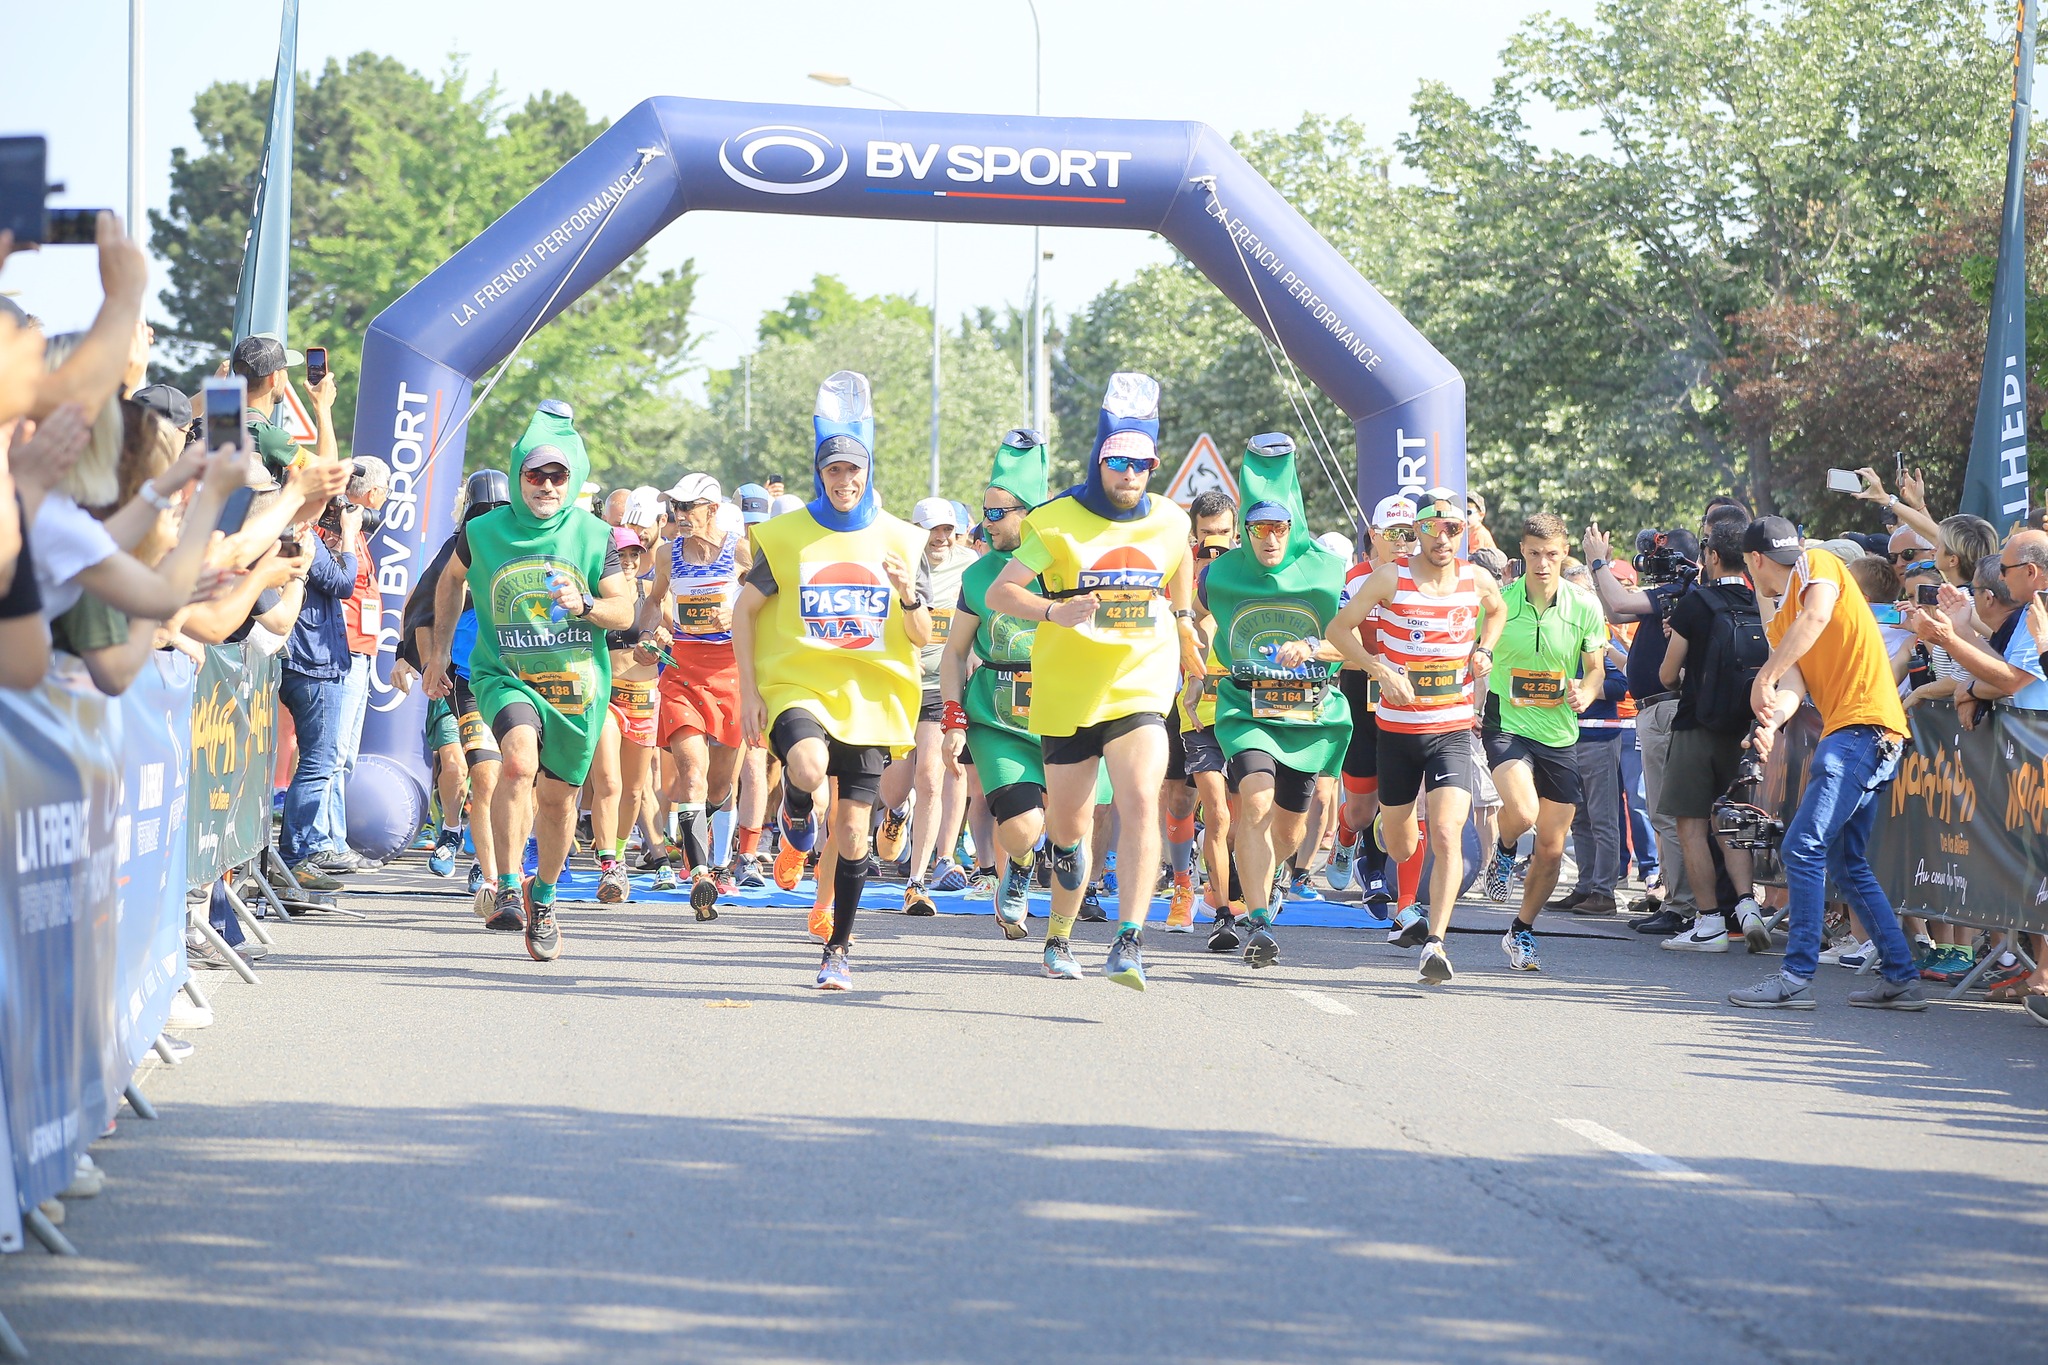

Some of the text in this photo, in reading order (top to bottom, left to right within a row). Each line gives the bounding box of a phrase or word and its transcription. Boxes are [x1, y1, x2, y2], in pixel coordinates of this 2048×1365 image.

[866, 140, 1133, 188] BV SPORT
[451, 166, 645, 328] LA FRENCH PERFORMANCE
[1205, 198, 1382, 373] LA FRENCH PERFORMANCE
[378, 381, 429, 597] BV SPORT
[1386, 510, 1401, 518] Red
[496, 577, 521, 614] BEAUTY
[522, 573, 533, 584] IS
[686, 607, 712, 618] 42 25
[1106, 606, 1146, 619] 42 173
[806, 619, 882, 640] MAN
[1261, 612, 1272, 624] IS
[1274, 612, 1286, 624] IN
[1288, 616, 1307, 631] THE
[498, 627, 592, 649] Lükinbetta
[1418, 675, 1454, 687] 42 000
[1522, 682, 1558, 693] 42 259
[549, 685, 570, 696] 138
[617, 692, 648, 703] 42 360
[1264, 691, 1302, 702] 42 164
[462, 725, 473, 736] 42
[15, 808, 39, 875] LA
